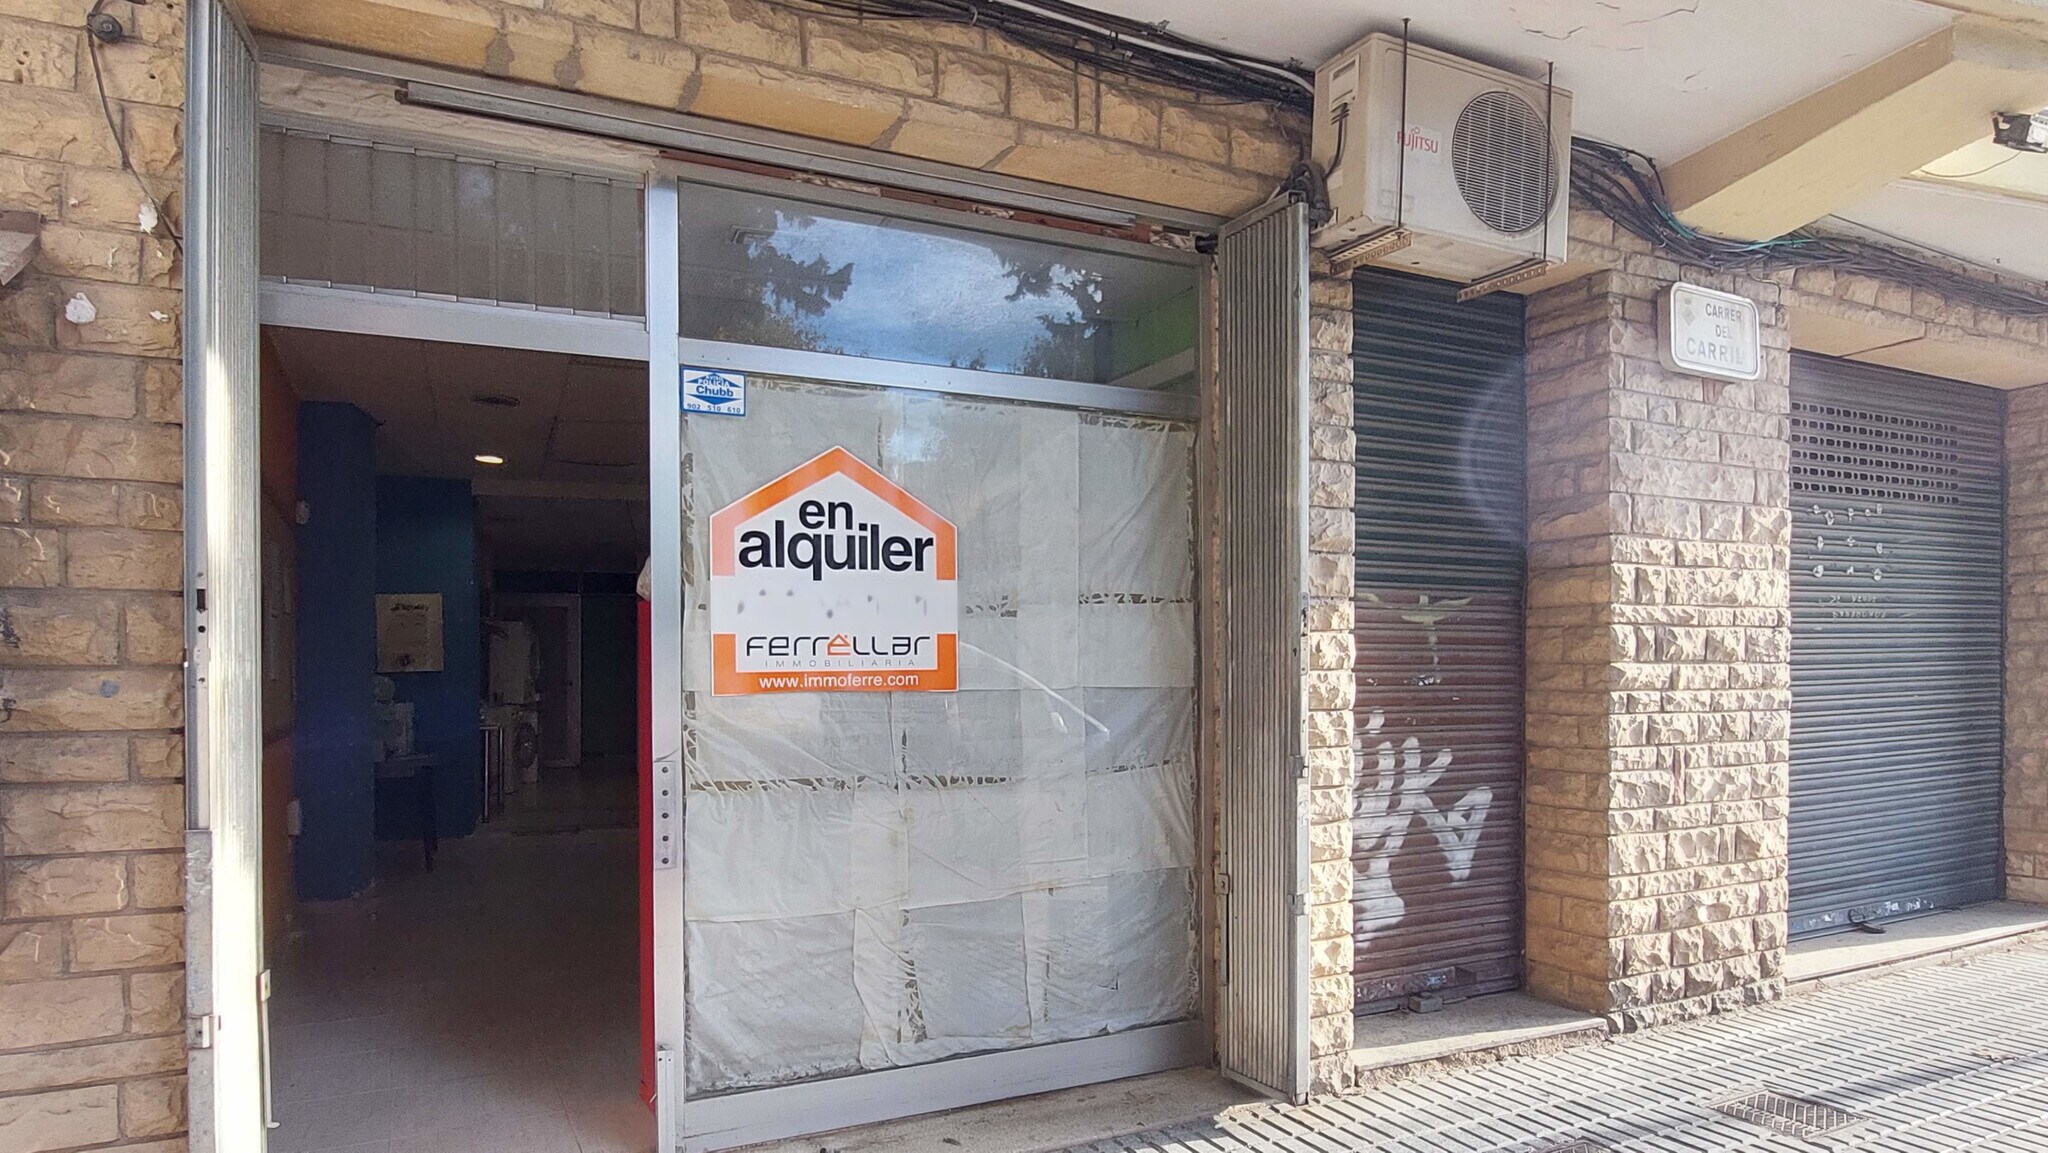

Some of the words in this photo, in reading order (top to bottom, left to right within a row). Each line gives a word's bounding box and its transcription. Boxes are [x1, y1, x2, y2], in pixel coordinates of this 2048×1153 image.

[1397, 126, 1438, 153] FUJITSU
[1705, 303, 1742, 322] CARRER
[1715, 324, 1733, 339] DEL
[1686, 338, 1743, 365] CARRIL
[696, 385, 734, 396] Chubb
[798, 499, 854, 530] en
[738, 519, 935, 581] alquiler
[765, 659, 916, 668] IMMOBILIARIA
[759, 673, 919, 689] www.immoferre.com
